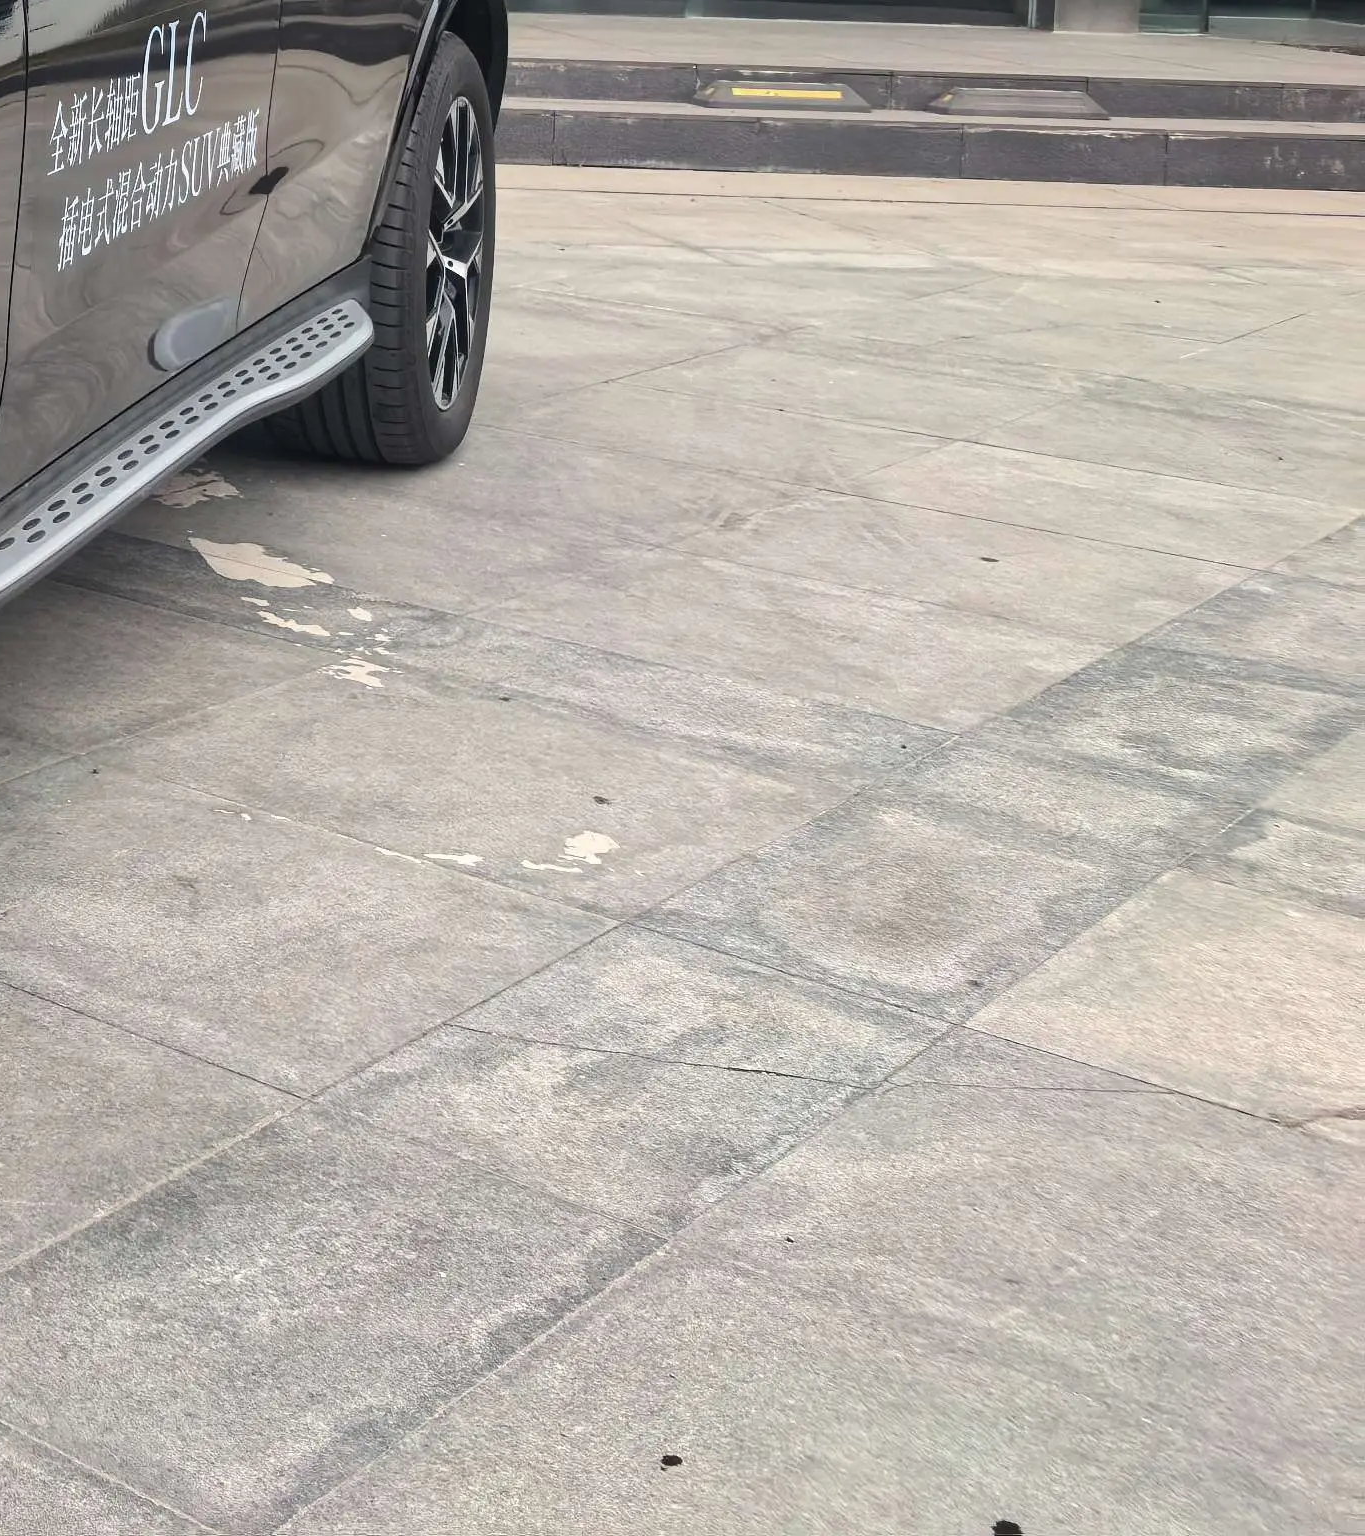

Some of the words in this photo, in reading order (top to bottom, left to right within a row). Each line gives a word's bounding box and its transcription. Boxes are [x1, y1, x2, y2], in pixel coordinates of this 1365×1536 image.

[57, 108, 260, 273] 插电式混合动力SUV典藏版
